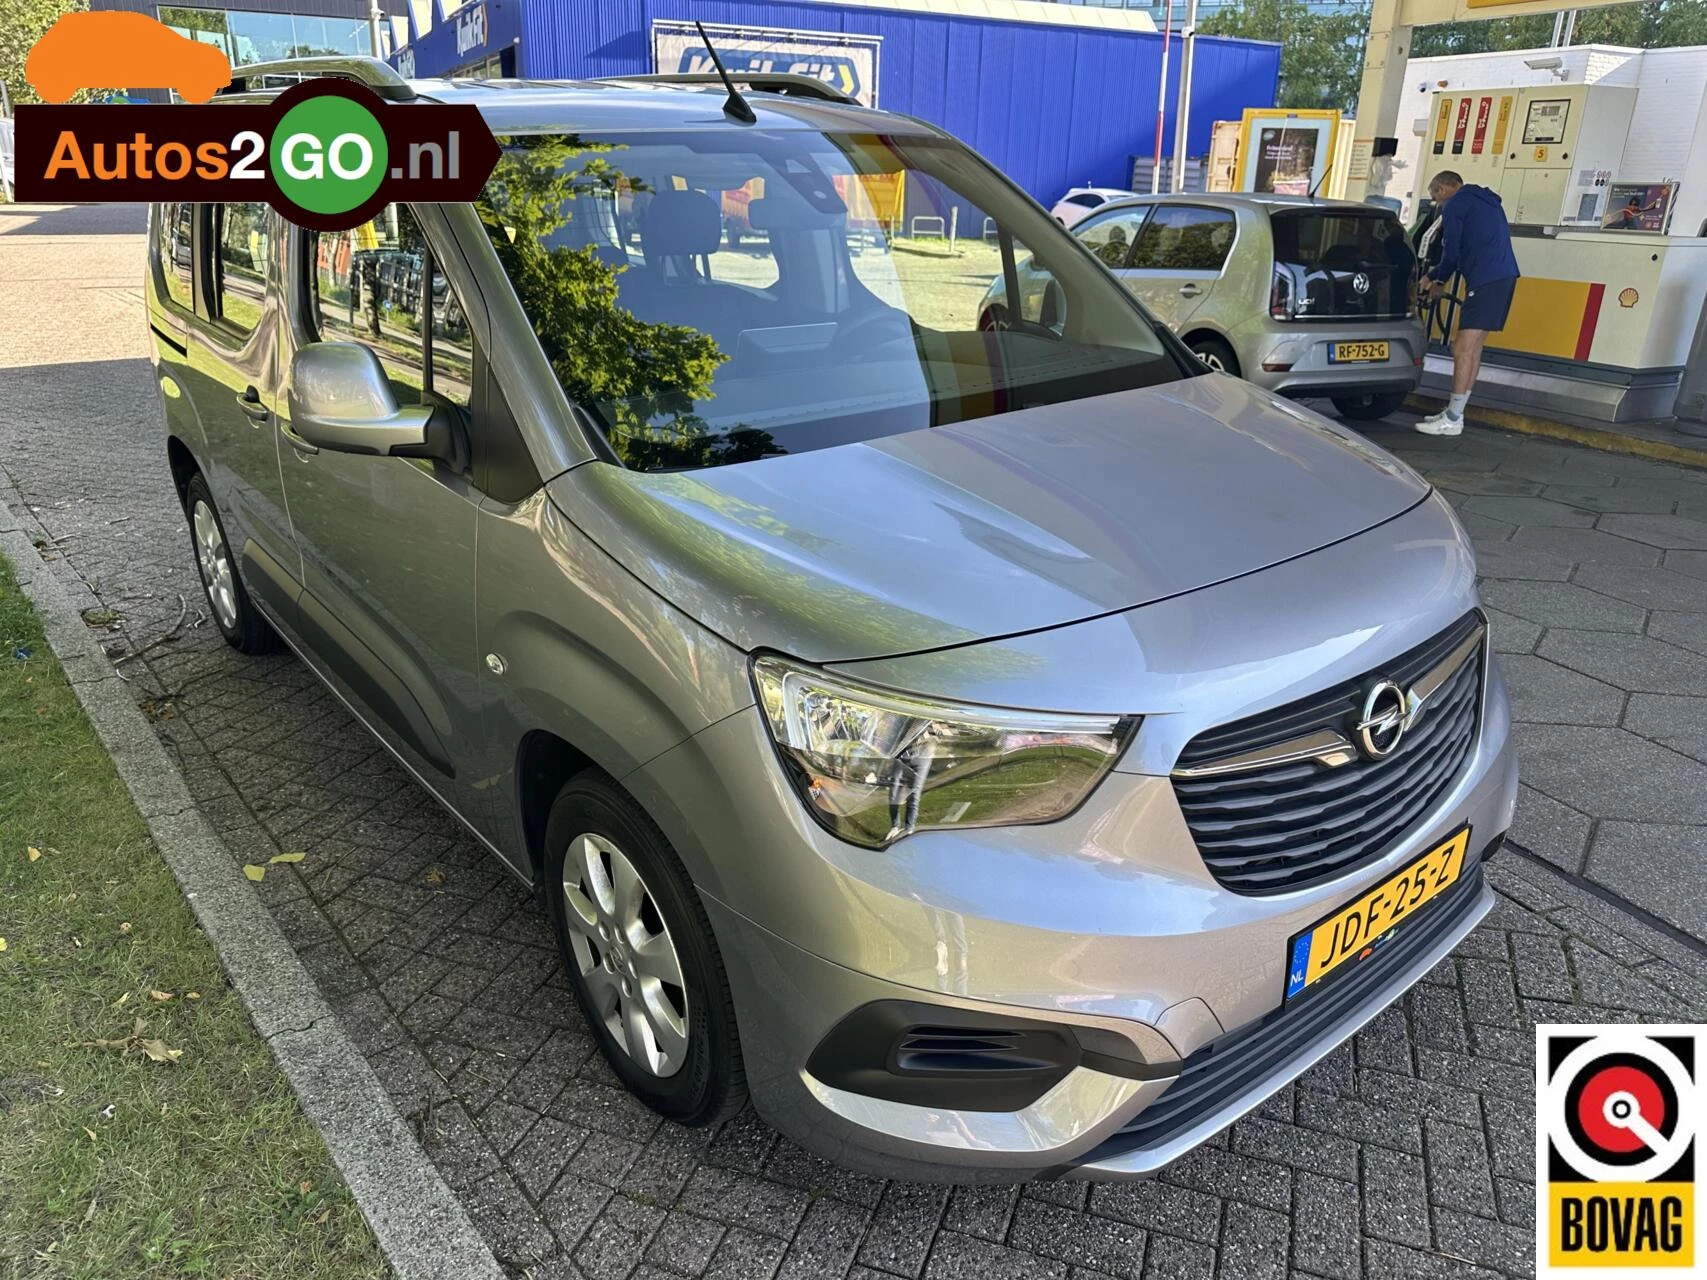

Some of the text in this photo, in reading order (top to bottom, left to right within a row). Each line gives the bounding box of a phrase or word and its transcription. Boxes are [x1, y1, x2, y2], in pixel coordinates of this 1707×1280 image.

[1537, 149, 1544, 159] 5
[1338, 344, 1385, 359] RF-752-G
[1320, 844, 1456, 969] JDF-25-Z
[1290, 969, 1304, 987] NL
